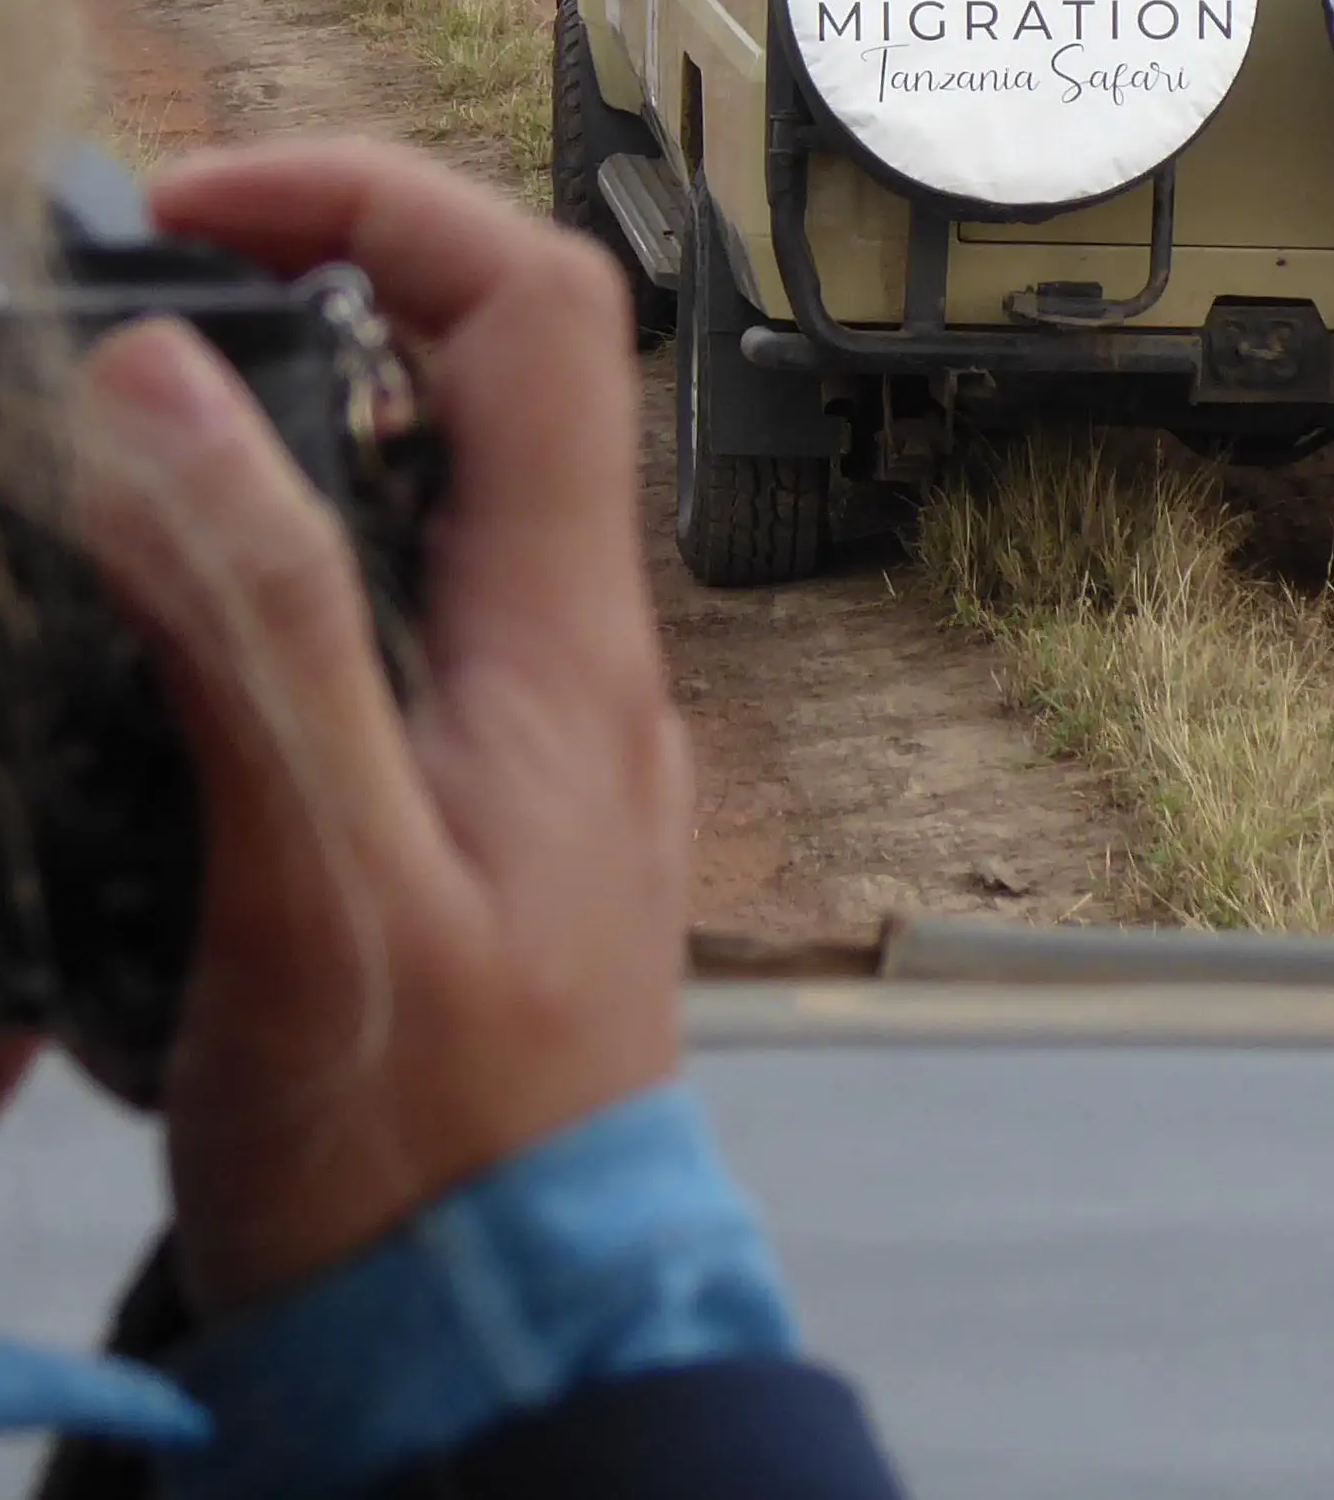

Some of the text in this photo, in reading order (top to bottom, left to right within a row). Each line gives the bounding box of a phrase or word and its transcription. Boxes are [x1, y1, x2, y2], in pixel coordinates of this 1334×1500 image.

[817, 0, 1233, 42] MIGRATION
[861, 43, 1190, 105] Tanzania Safari
